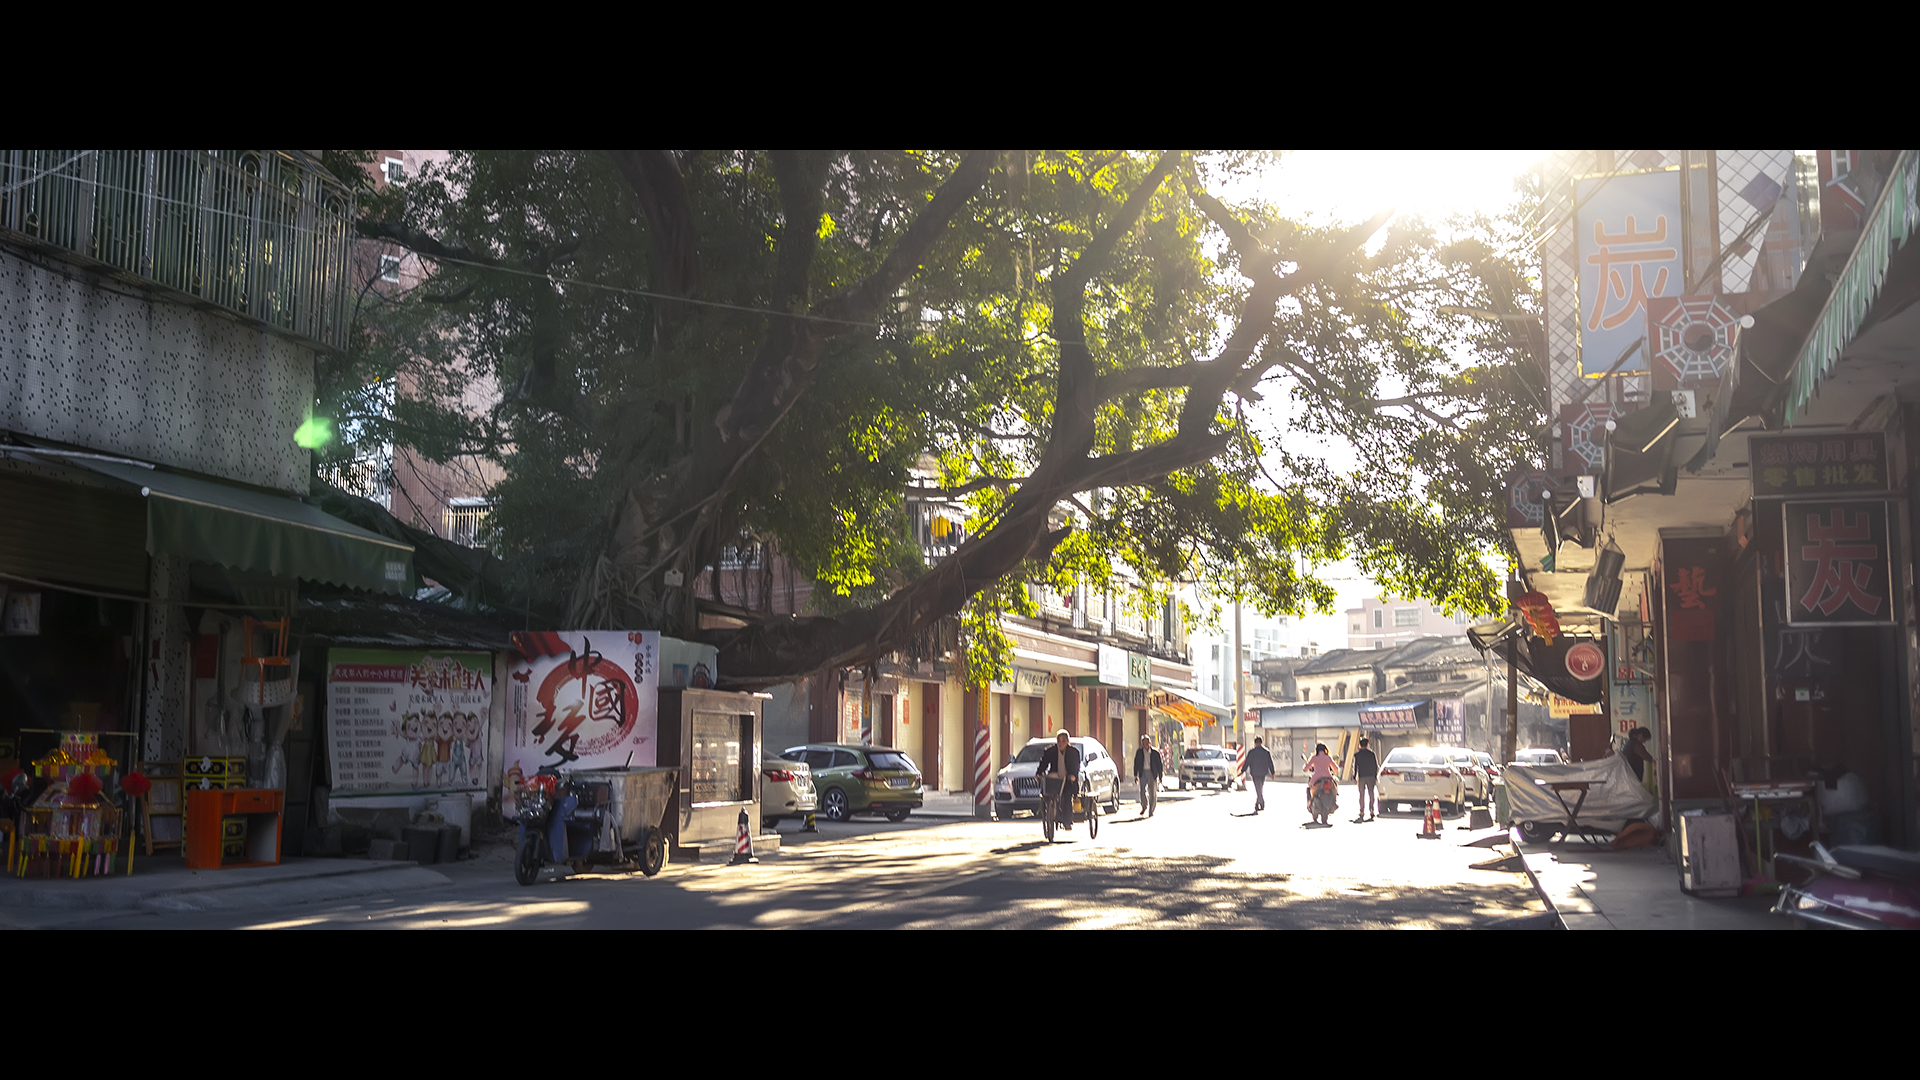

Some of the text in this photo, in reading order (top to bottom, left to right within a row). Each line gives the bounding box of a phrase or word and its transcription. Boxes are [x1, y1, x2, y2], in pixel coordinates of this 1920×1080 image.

[1587, 215, 1677, 331] 炭
[1763, 464, 1878, 487] 零售批发
[1801, 508, 1882, 616] 炭
[411, 660, 485, 693] 关爱未成年人
